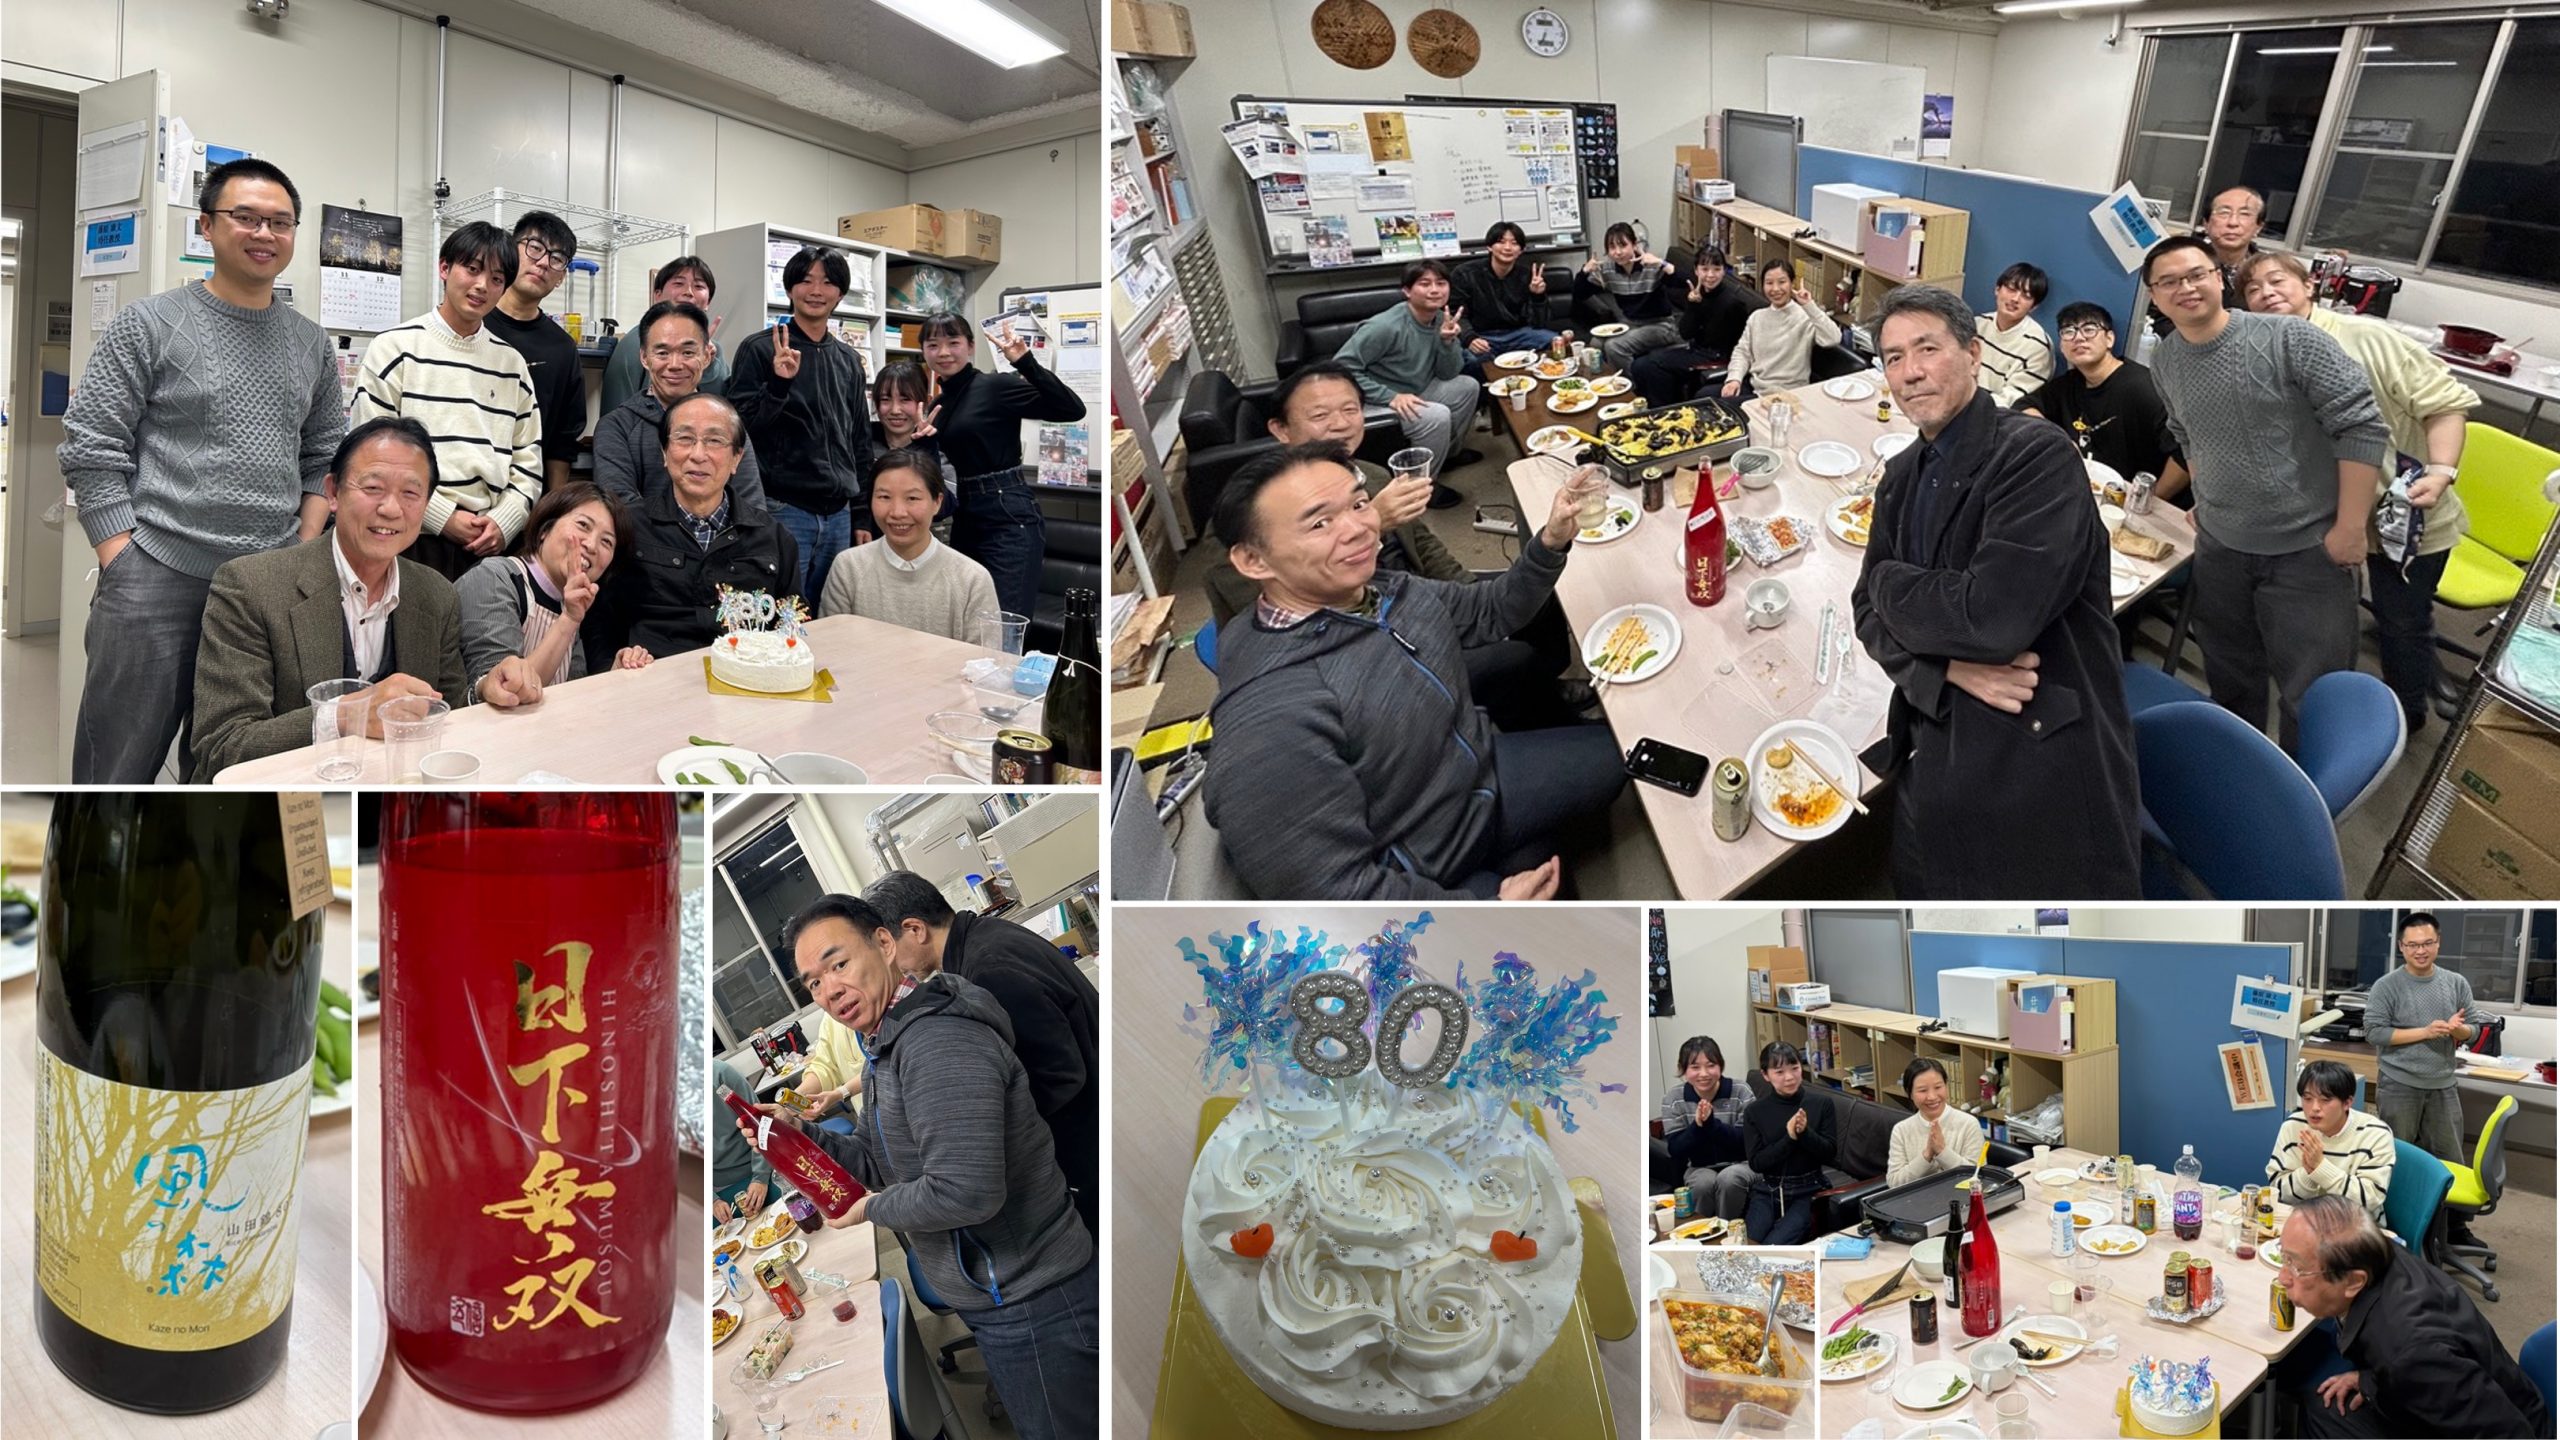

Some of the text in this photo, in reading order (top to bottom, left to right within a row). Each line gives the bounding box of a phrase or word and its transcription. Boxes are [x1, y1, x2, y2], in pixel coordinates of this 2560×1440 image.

[738, 592, 776, 622] 80
[1290, 970, 1470, 1089] 80
[482, 940, 622, 1331] 日下無双
[597, 988, 617, 1297] HINOSHITA MUSOU
[148, 1323, 172, 1334] Kaze
[189, 1324, 210, 1334] Mori
